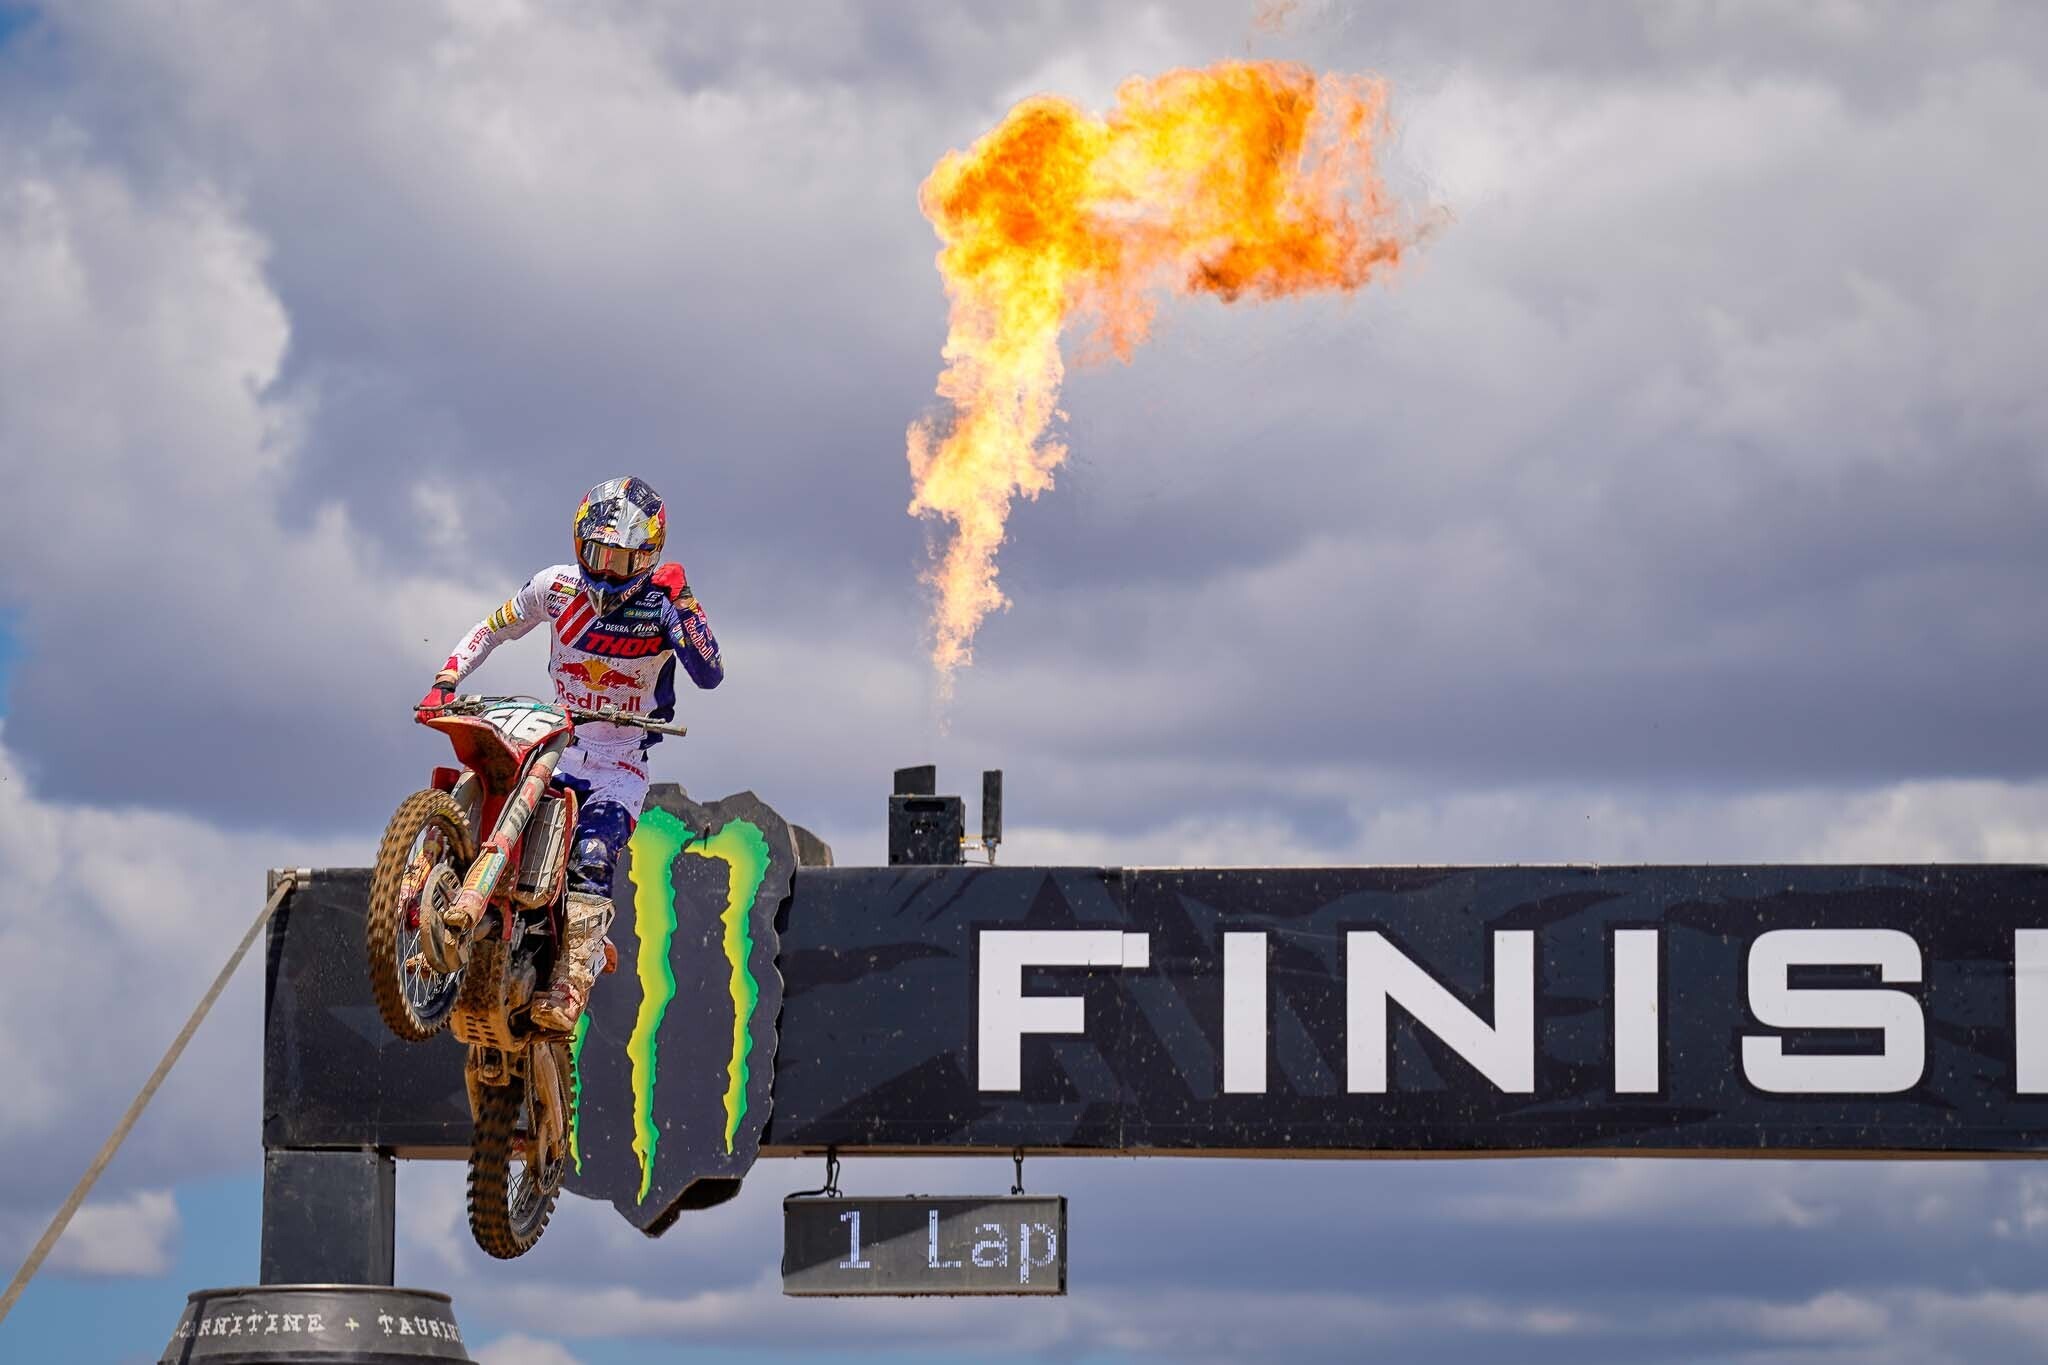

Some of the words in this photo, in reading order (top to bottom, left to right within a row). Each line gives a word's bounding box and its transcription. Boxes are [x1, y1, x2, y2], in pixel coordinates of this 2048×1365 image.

[585, 632, 664, 657] THOR
[605, 623, 629, 633] DEKRA
[683, 616, 704, 642] Red
[694, 638, 715, 661] Bull
[556, 679, 592, 710] Red
[978, 928, 2048, 1094] FINIS
[839, 1210, 870, 1269] 1
[928, 1209, 1057, 1285] Lap
